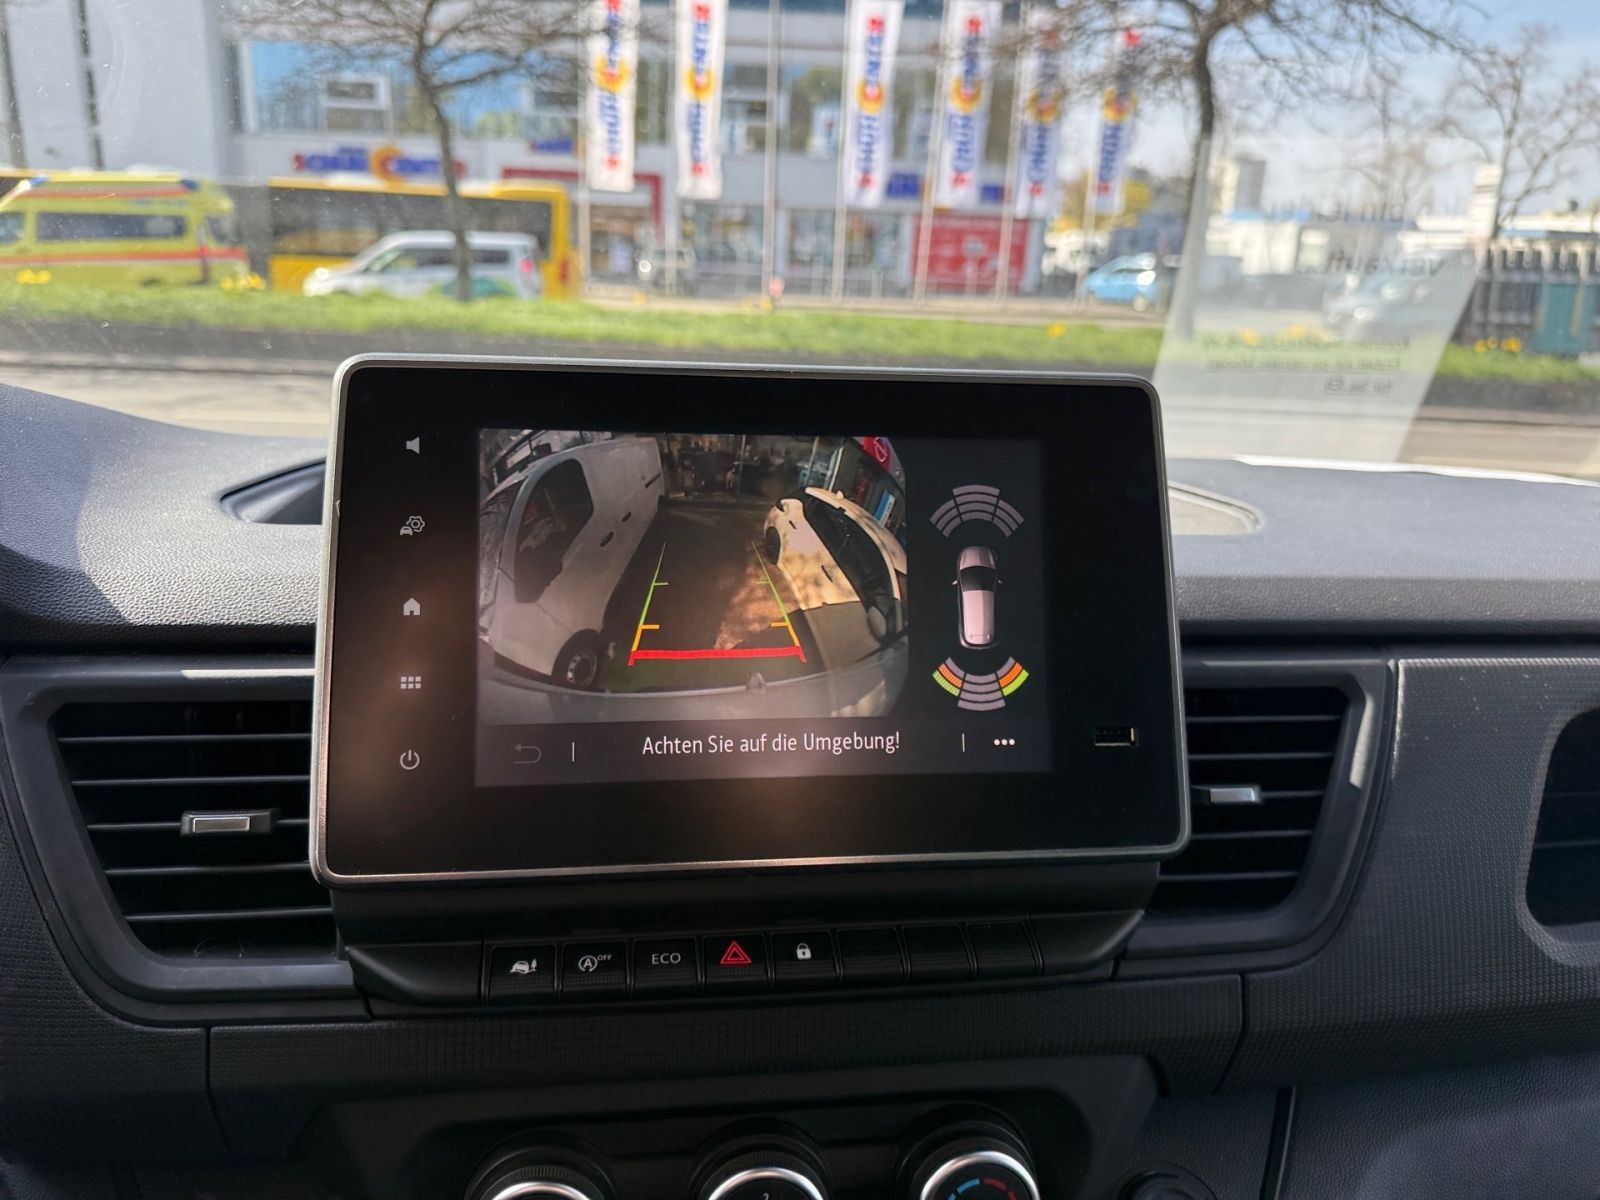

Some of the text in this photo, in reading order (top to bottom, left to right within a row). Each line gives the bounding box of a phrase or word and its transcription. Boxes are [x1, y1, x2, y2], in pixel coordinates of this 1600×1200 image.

[642, 731, 900, 755] Achten Sie auf die Umgebung!
[651, 952, 682, 965] ECO
